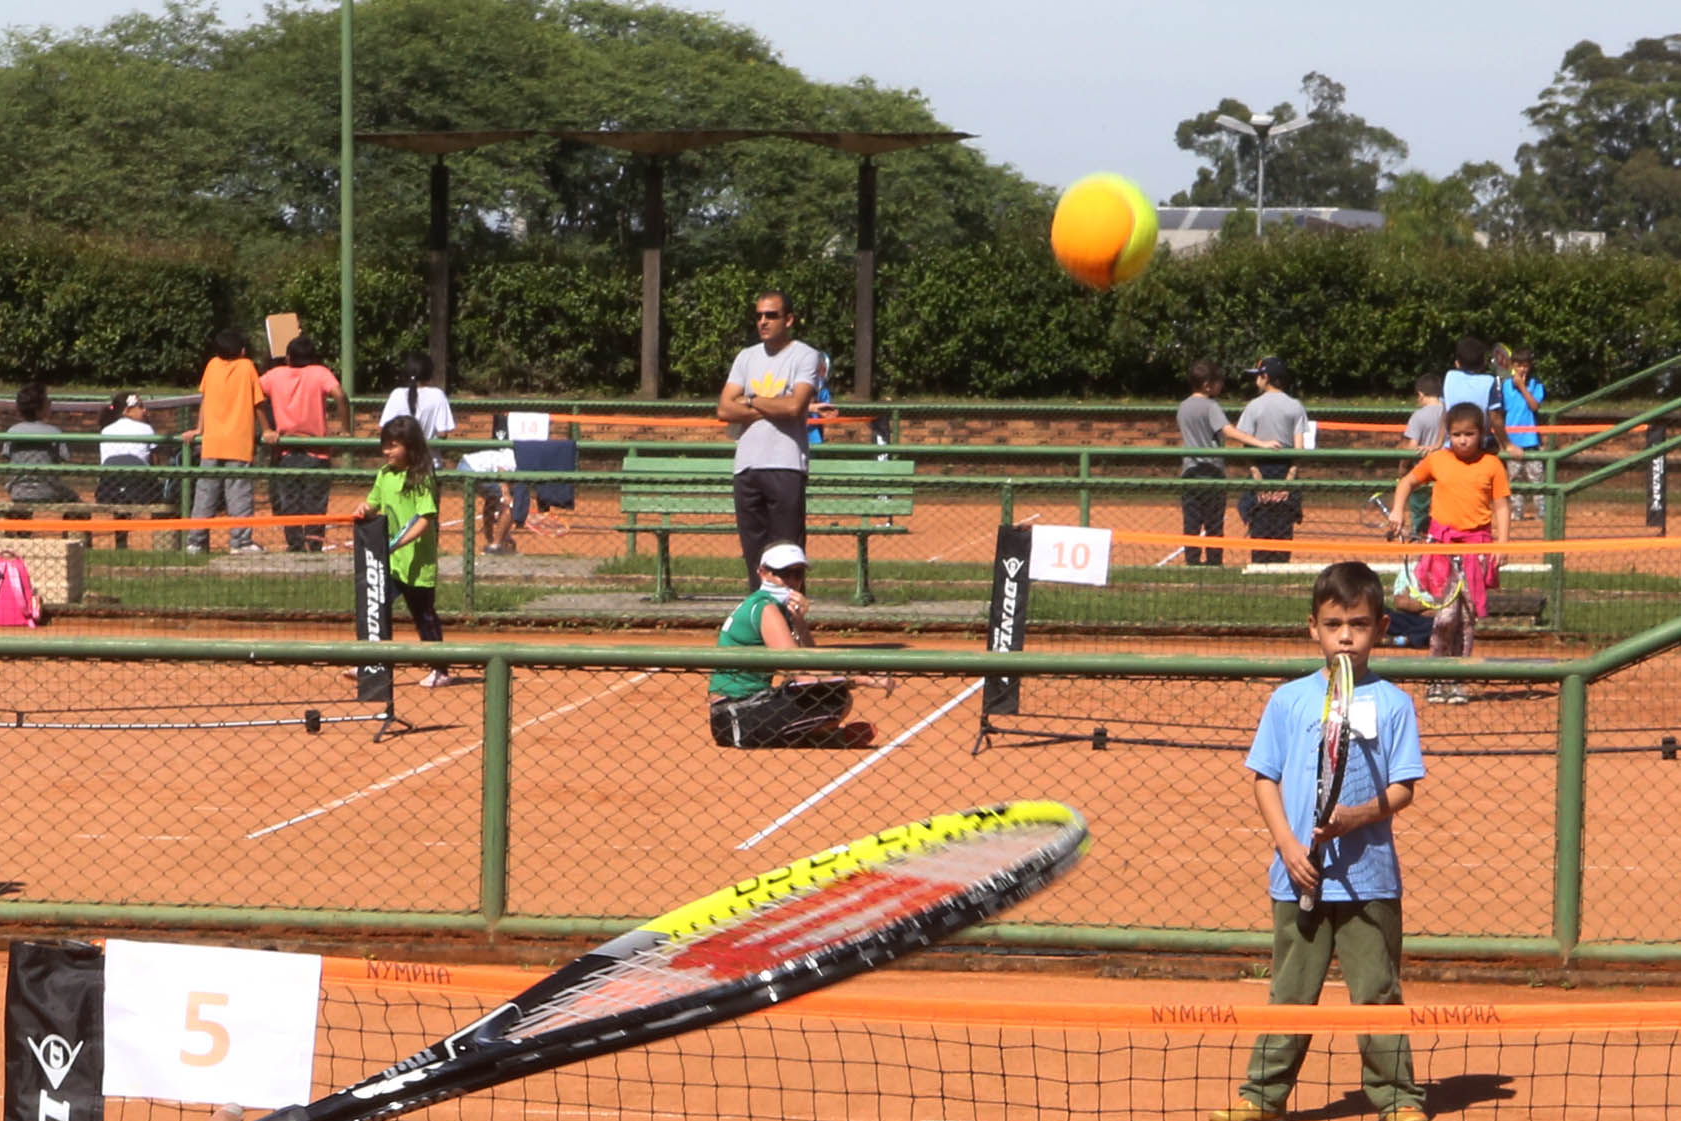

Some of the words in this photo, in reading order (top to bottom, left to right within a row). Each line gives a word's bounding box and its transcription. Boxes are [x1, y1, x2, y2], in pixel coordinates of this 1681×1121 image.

[1051, 541, 1091, 570] 10
[365, 959, 453, 985] NYMPHA
[1150, 1004, 1238, 1025] NYMPHA
[1409, 1004, 1501, 1026] NYMPHA
[178, 991, 231, 1068] 5
